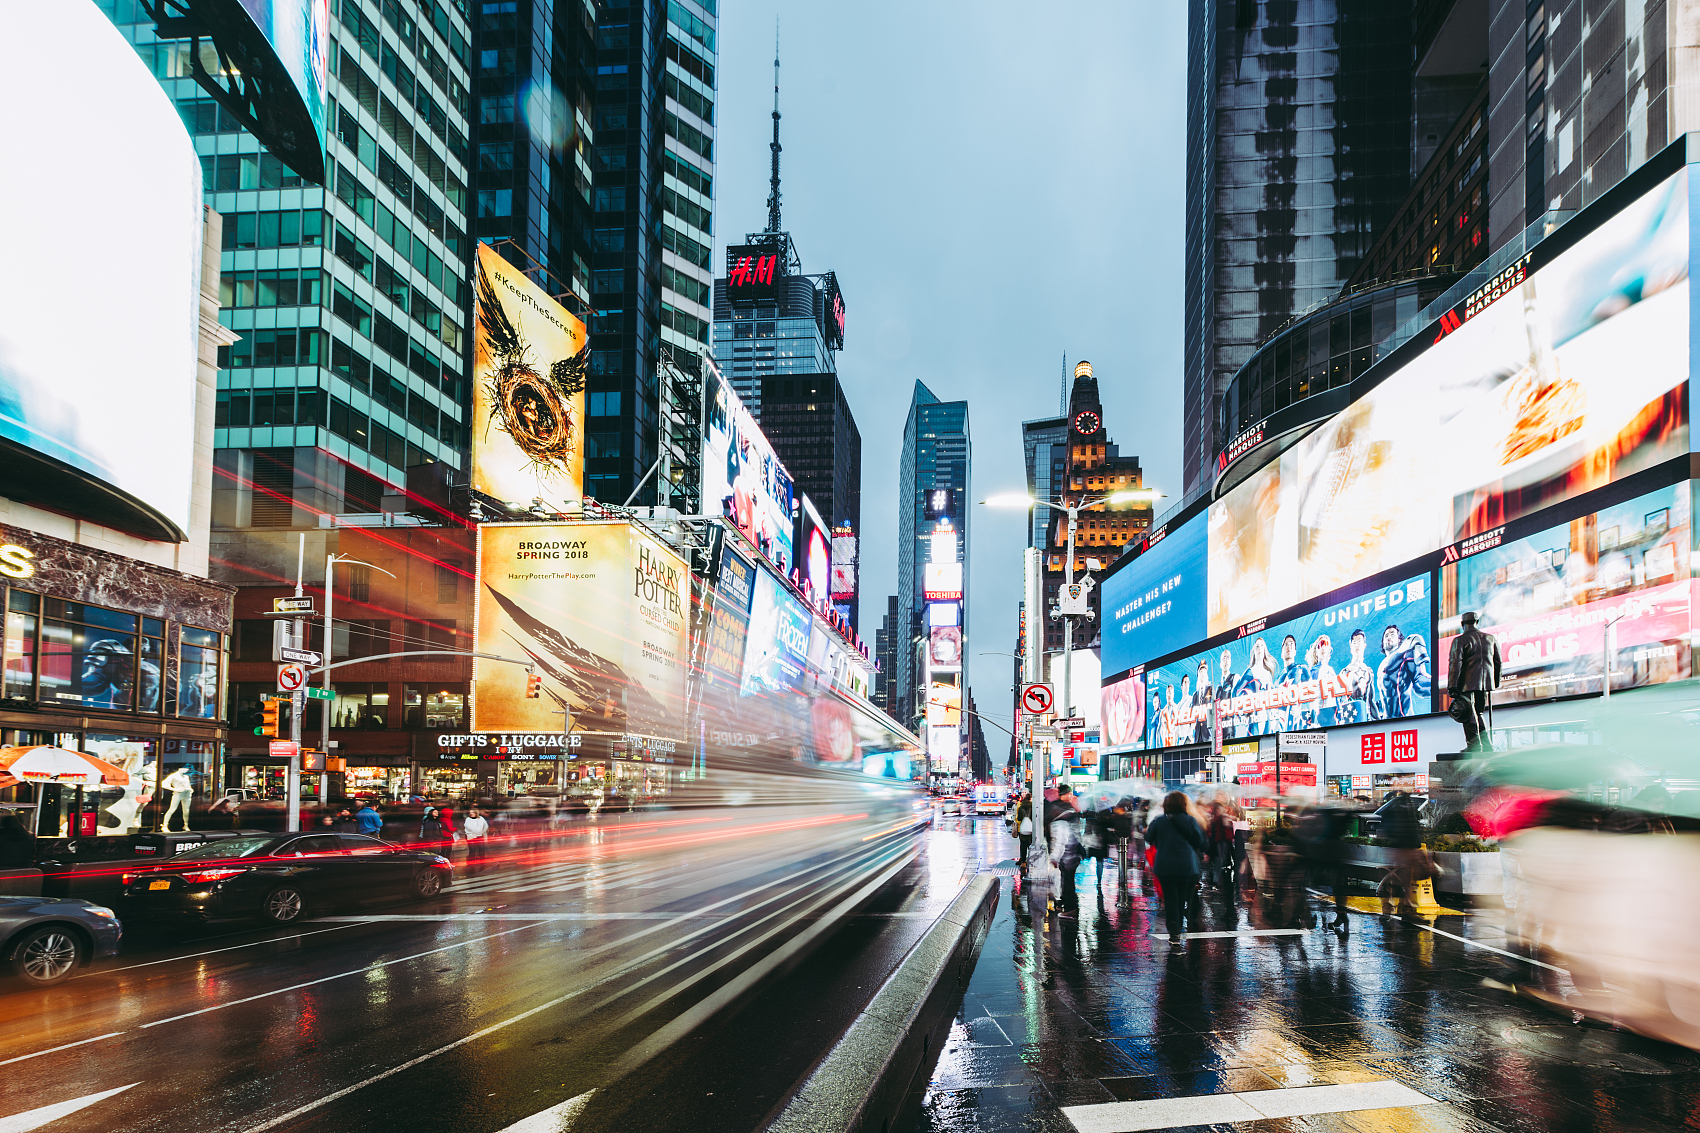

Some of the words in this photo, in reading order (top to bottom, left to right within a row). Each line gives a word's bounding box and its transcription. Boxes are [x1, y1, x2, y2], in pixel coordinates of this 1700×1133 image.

[730, 254, 777, 287] H&M
[1466, 252, 1533, 308] MARRIOTT
[494, 271, 577, 340] #KeepTheSecrets
[1466, 271, 1524, 319] MARQUIS
[1229, 420, 1268, 451] MARRIOTT
[1229, 433, 1262, 461] MARQUIS
[518, 541, 588, 550] BROADWAY
[1462, 526, 1506, 548] MARRIOTT
[1462, 536, 1500, 556] MARQUIS
[516, 551, 560, 560] SPRING
[564, 551, 589, 559] 2018
[639, 542, 682, 594] HARRY
[508, 572, 596, 581] HarryPotterThePlay.com
[634, 566, 684, 620] POTTER
[1116, 597, 1143, 619] MASTER
[1145, 590, 1159, 606] HIS
[1162, 575, 1182, 593] NEW
[640, 604, 662, 623] CURSED
[663, 616, 679, 631] CHILD
[1122, 601, 1172, 634] CHALLENGE?
[1324, 589, 1404, 626] UNITED
[717, 608, 744, 640] COME
[777, 610, 809, 657] FROZEN
[643, 640, 675, 659] BROADWAY
[713, 626, 742, 658] FROM
[1546, 633, 1580, 656] US
[1633, 645, 1676, 662] NETFLIX
[642, 650, 662, 664] SPRING
[710, 646, 740, 674] AWAY
[1174, 702, 1212, 726] HELPIN
[1220, 680, 1320, 718] SUPERHEROES
[1320, 672, 1354, 700] FLY
[438, 735, 487, 747] GIFTS
[500, 735, 581, 747] LUGGAGE
[648, 739, 676, 752] LUGGAGE
[1394, 733, 1414, 746] UNI
[1394, 747, 1415, 761] QLO
[59, 773, 87, 782] NUTS
